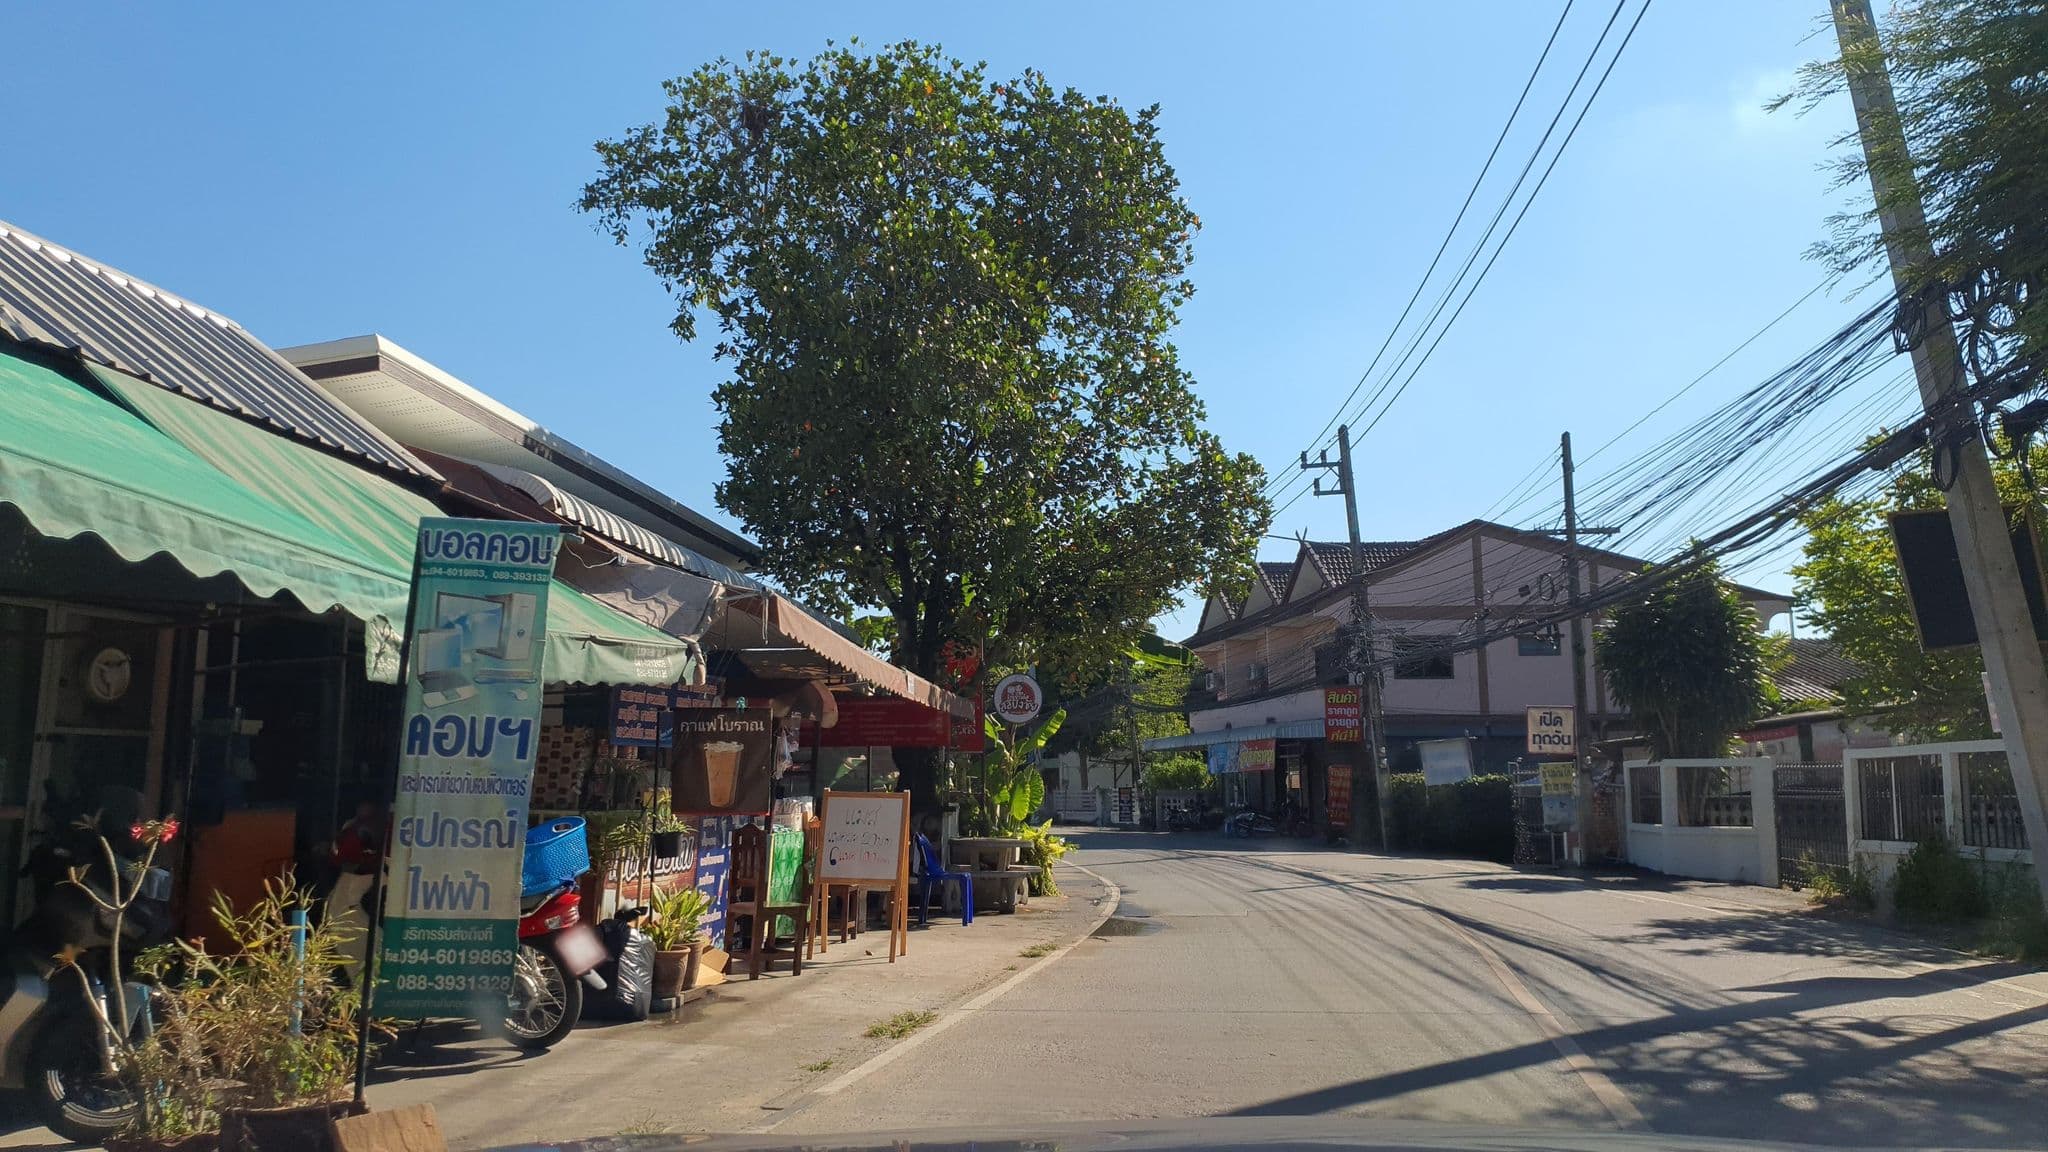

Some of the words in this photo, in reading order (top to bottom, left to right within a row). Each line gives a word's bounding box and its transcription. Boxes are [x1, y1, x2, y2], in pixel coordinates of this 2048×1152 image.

[423, 530, 554, 565] บอลคอม
[1328, 691, 1357, 704] สินค้า
[1328, 707, 1358, 718] ราคาถูก
[1540, 712, 1563, 727] เปิด
[680, 715, 765, 732] กาแฟโบราณ
[406, 713, 532, 760] คอมฯ
[1532, 730, 1572, 751] ทุกวัน
[408, 866, 490, 911] ไฟฟ้า
[397, 974, 511, 991] 088-3931328
